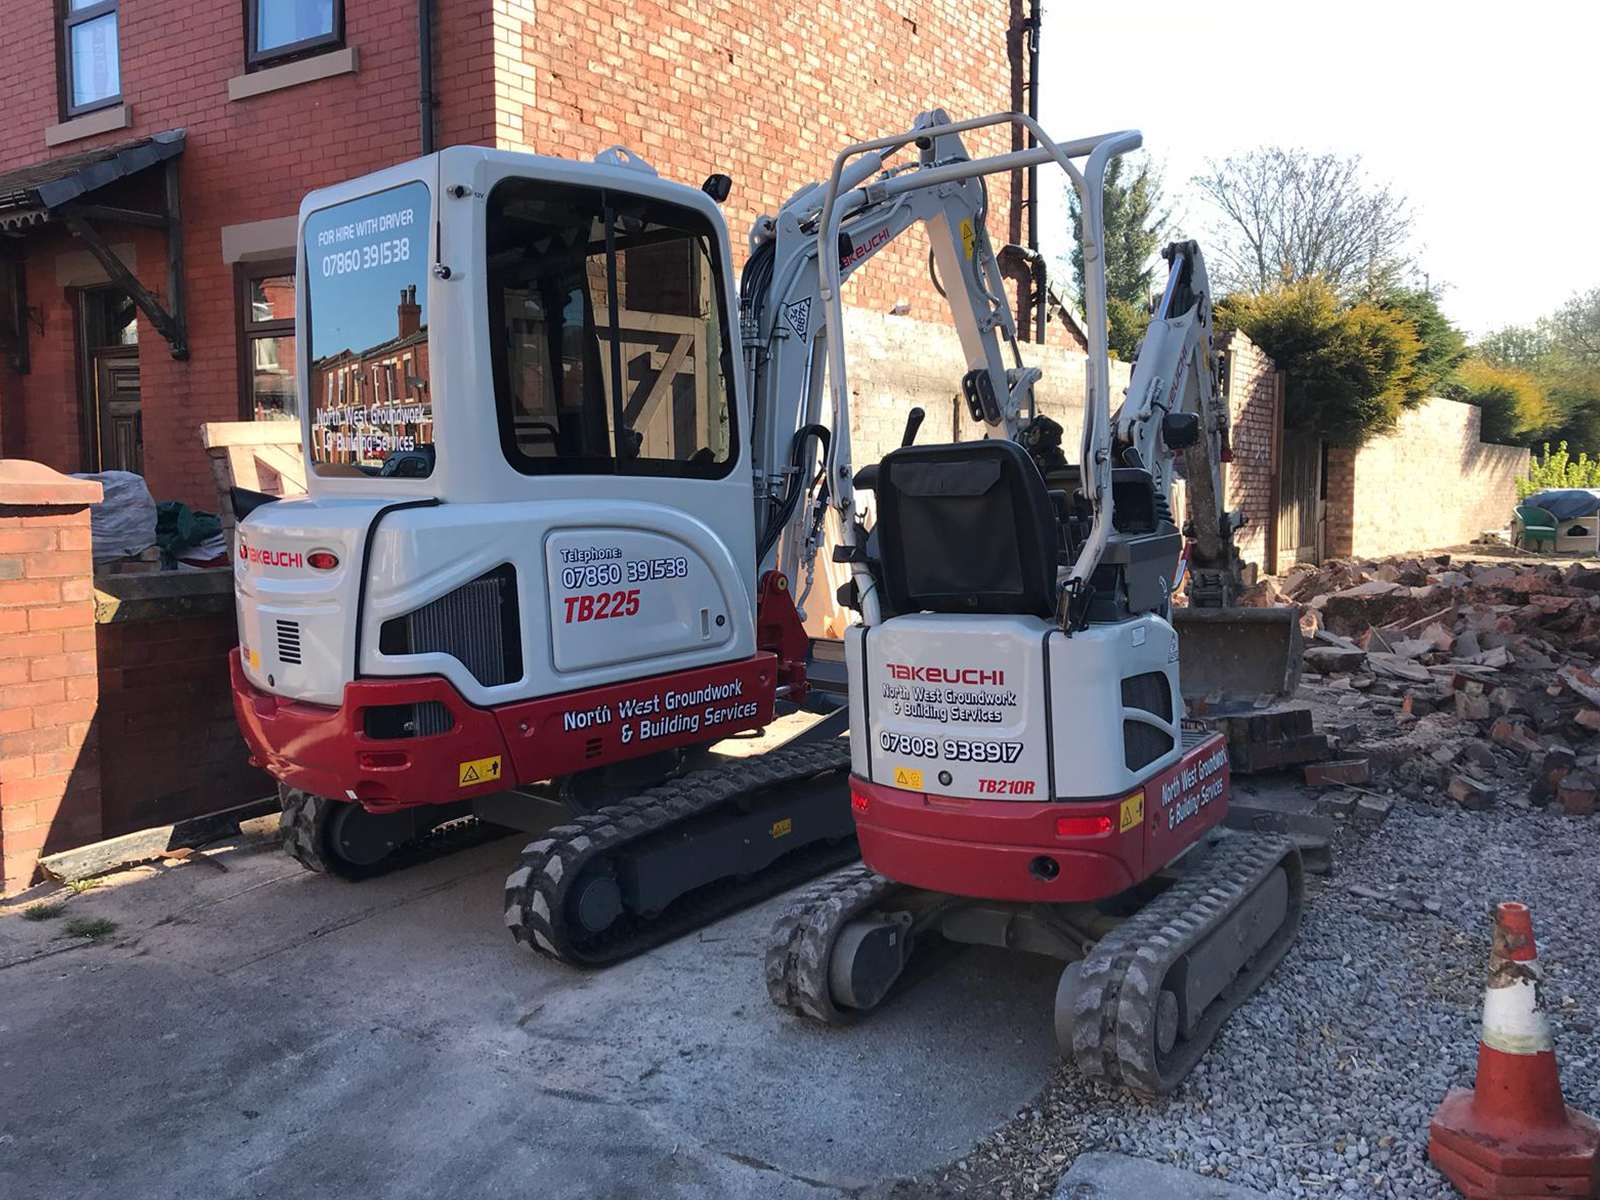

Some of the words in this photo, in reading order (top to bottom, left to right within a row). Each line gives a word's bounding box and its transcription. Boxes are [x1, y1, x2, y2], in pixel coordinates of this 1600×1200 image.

[318, 231, 335, 247] FOR
[335, 224, 354, 242] HIRE
[355, 218, 378, 237] WITH
[379, 208, 414, 231] DRIVER
[322, 250, 361, 277] 07860
[363, 237, 410, 269] 391538
[316, 407, 341, 426] North
[344, 404, 368, 426] West
[370, 402, 426, 425] Groundwork
[375, 431, 415, 452] Services
[560, 547, 622, 564] Telephone:
[562, 563, 621, 589] 07860
[626, 556, 688, 582] 391538
[563, 589, 641, 624] TB225
[563, 705, 612, 731] North
[618, 697, 660, 719] West
[664, 678, 743, 711] Groundwork
[882, 682, 910, 701] North
[912, 686, 942, 703] West
[944, 688, 1018, 707] Groundwork
[620, 722, 633, 744] &
[639, 713, 700, 741] Building
[704, 701, 758, 727] Services
[893, 702, 901, 716] &
[904, 702, 948, 723] Building
[951, 705, 1003, 723] Services
[880, 731, 938, 758] 07808
[943, 738, 1024, 764] 938917
[978, 779, 1036, 796] TB210R
[1162, 776, 1180, 806] North
[1181, 764, 1197, 791] West
[1199, 745, 1227, 781] Groundwork
[1176, 794, 1199, 824] Building
[1201, 778, 1222, 805] Services
